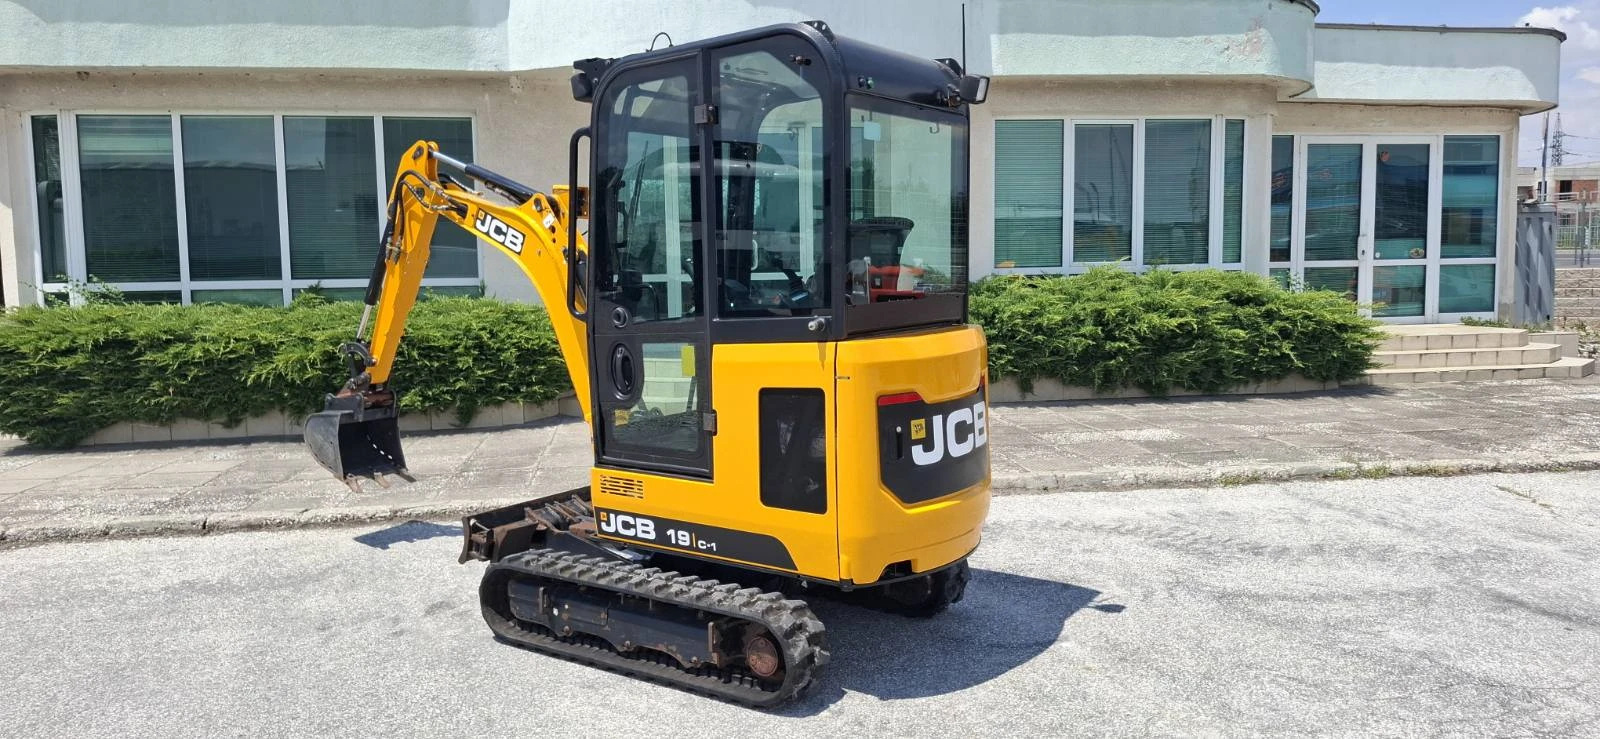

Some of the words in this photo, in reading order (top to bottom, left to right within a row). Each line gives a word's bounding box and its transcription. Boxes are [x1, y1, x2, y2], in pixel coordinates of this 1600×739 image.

[475, 213, 524, 253] JCB
[911, 401, 987, 466] JCB
[600, 513, 656, 540] JCB
[666, 529, 691, 546] 19
